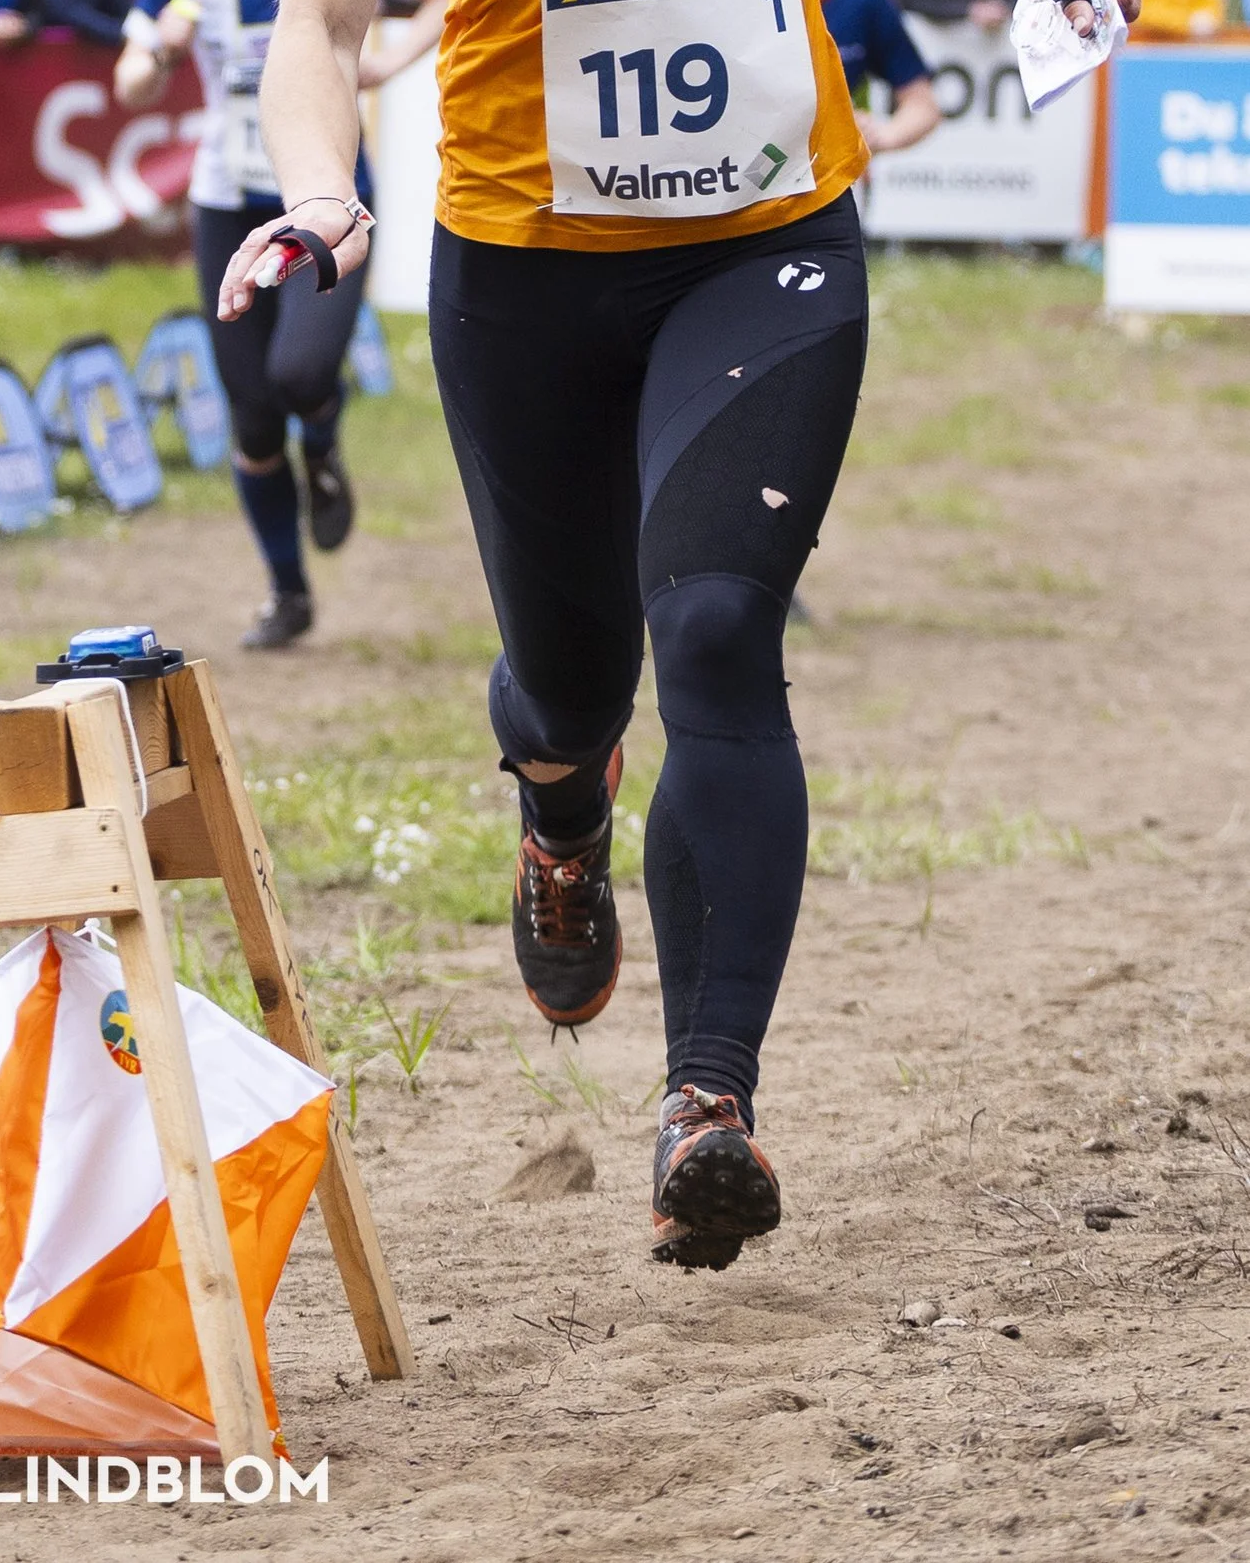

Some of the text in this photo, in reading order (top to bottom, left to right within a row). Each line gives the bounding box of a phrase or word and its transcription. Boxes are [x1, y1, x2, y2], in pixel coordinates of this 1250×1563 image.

[579, 43, 729, 139] 119
[584, 156, 740, 200] Valmet
[119, 1051, 139, 1073] TYR
